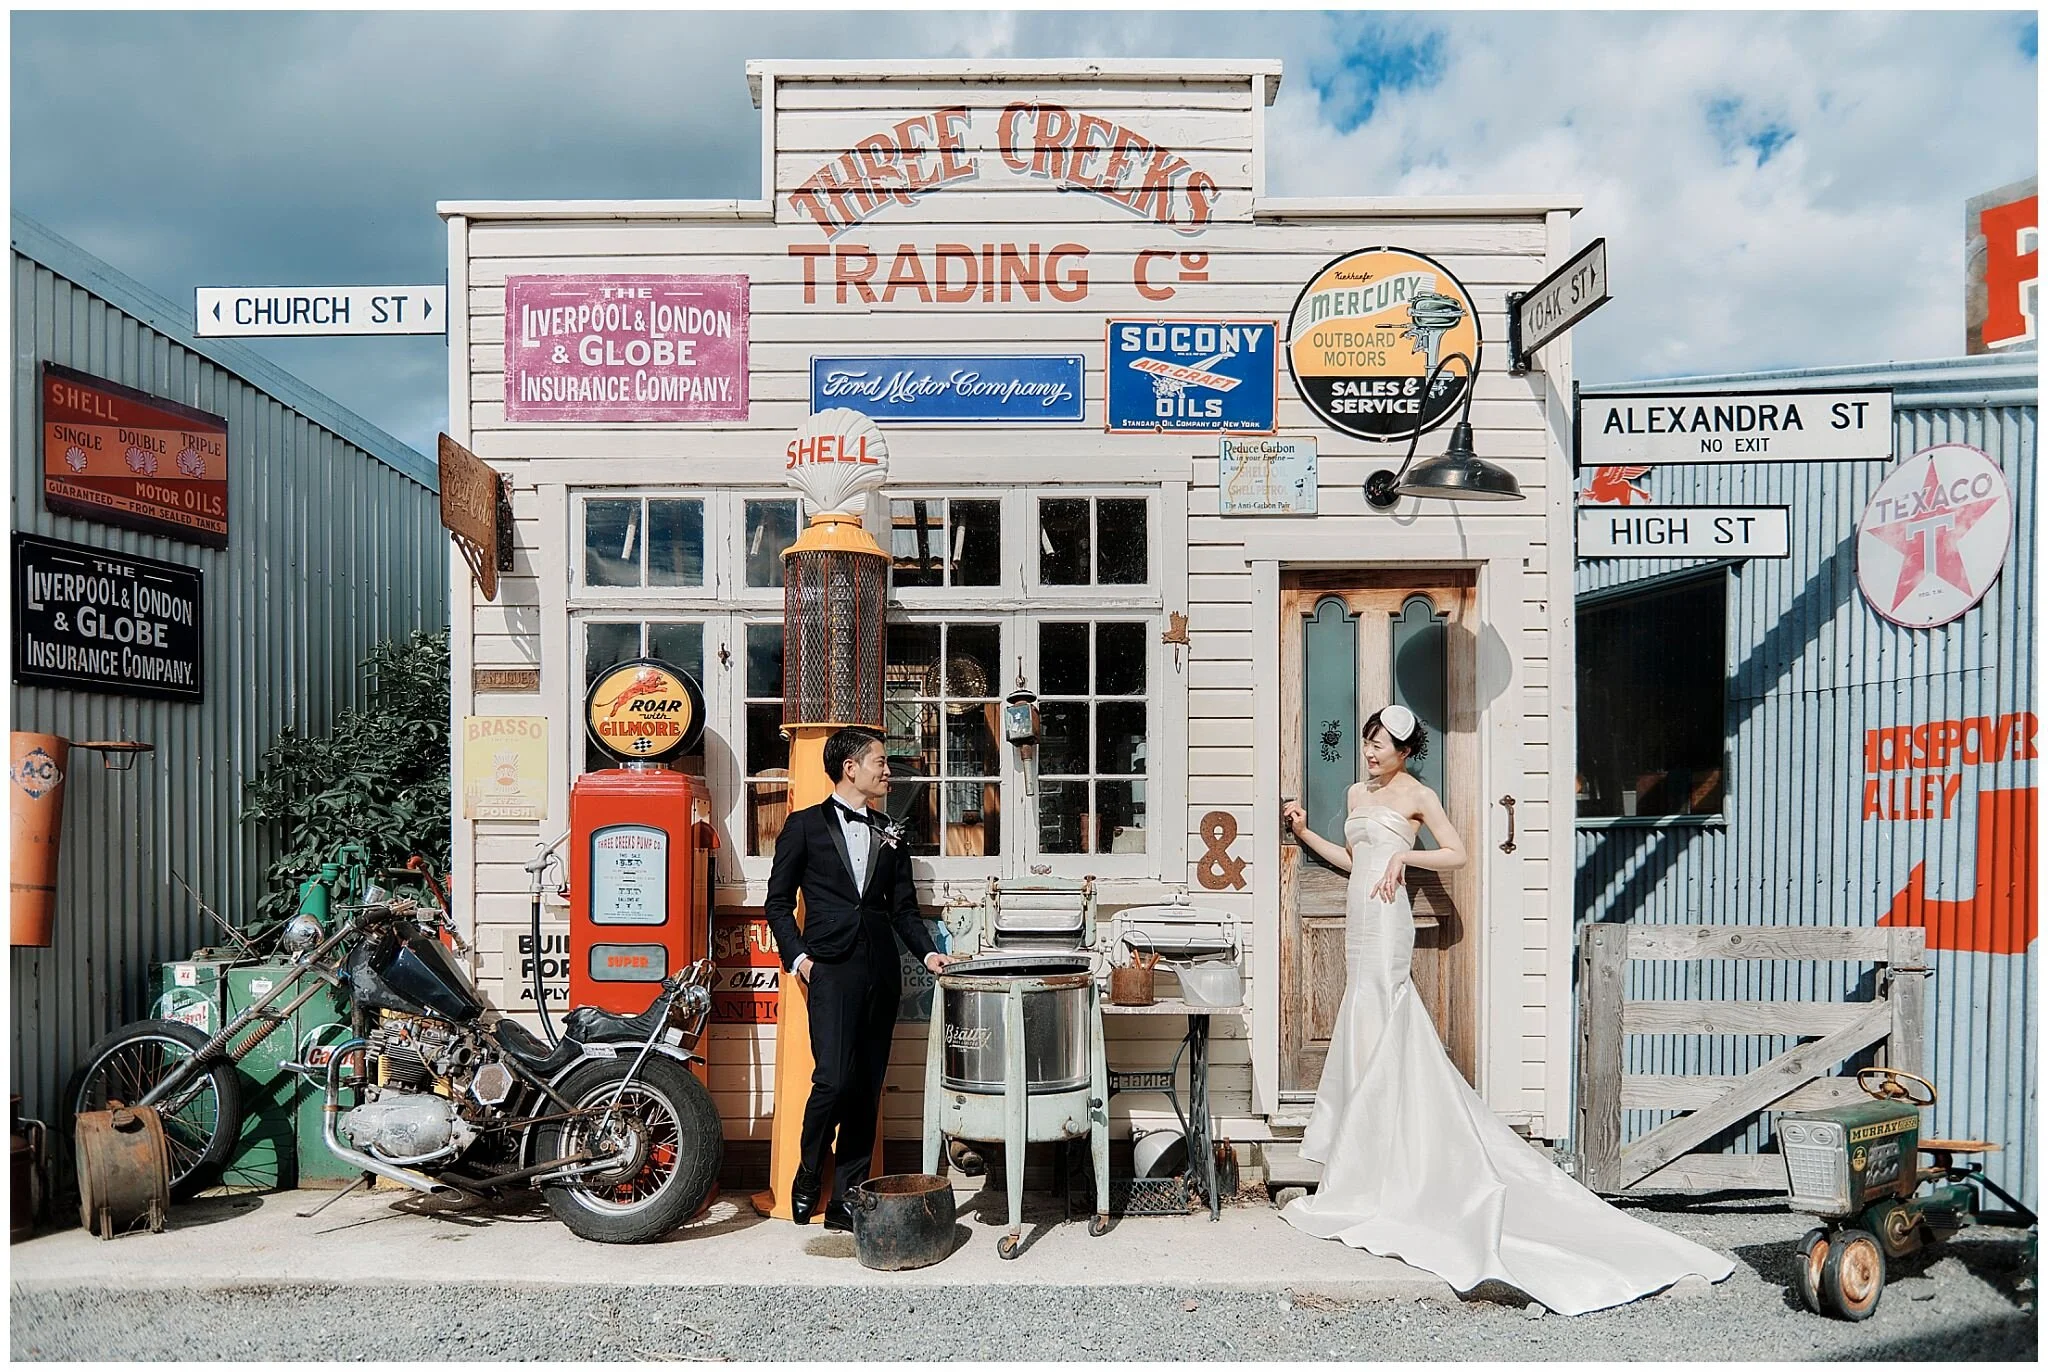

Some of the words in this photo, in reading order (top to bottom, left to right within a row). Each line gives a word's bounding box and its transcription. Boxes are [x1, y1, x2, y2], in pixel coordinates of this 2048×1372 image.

[788, 105, 980, 242] THREE
[995, 101, 1222, 238] CREEKS
[787, 243, 1092, 304] TRADING
[599, 288, 653, 299] THE
[1311, 277, 1421, 323] MERCURY
[1535, 286, 1562, 331] OAK
[1571, 266, 1588, 305] ST
[235, 297, 350, 325] CHURCH
[371, 296, 408, 323] ST
[522, 303, 632, 348] LIVERPOOL
[634, 310, 646, 331] &
[650, 301, 732, 339] LONDON
[551, 345, 571, 364] &
[578, 335, 697, 366] GLOBE
[1121, 327, 1263, 353] SOCONY
[1313, 332, 1396, 348] OUTBOARD
[1324, 351, 1386, 367] MOTORS
[521, 370, 630, 402] INSURANCE
[823, 371, 883, 398] Ford
[877, 370, 951, 404] Motor
[950, 369, 1073, 407] Company
[1331, 381, 1399, 397] SALES
[1402, 378, 1420, 396] &
[52, 383, 119, 422] SHELL
[1156, 399, 1223, 418] OILS
[1331, 399, 1420, 414] SERVICE
[1162, 419, 1174, 427] OIL
[1176, 420, 1210, 428] COMPANY
[1223, 420, 1239, 428] NEW
[1240, 420, 1260, 428] YORK
[1603, 403, 1804, 434] ALEXANDRA
[1830, 401, 1870, 430] ST
[54, 424, 102, 450] SINGLE
[118, 429, 166, 454] DOUBLE
[180, 432, 221, 456] TRIPLE
[786, 434, 879, 470] SHELL
[1223, 440, 1259, 461] Reduce
[1260, 441, 1295, 453] Carbon
[1701, 438, 1723, 453] NO
[1735, 437, 1770, 453] EXIT
[49, 482, 113, 506] GUARANTEED
[129, 501, 155, 516] FROM
[159, 509, 192, 525] SEALED
[136, 482, 179, 506] MOTOR
[184, 489, 225, 518] OILS.
[1876, 472, 1993, 523] TEXACO
[1611, 517, 1689, 545] HIGH
[1714, 517, 1755, 544] ST
[1906, 512, 1955, 576] T
[92, 560, 135, 578] THE
[27, 564, 119, 611] LIVERPOOL
[121, 587, 131, 609] &
[133, 581, 192, 626] LONDON
[53, 611, 70, 632] &
[76, 606, 168, 648] GLOBE
[27, 632, 118, 676] INSURANCE
[480, 671, 536, 686] ANTIQUES
[629, 699, 682, 712] ROAR
[468, 719, 542, 741] BRASSO
[600, 721, 681, 737] GILMORE
[1863, 773, 1962, 821] ALLEY
[480, 806, 531, 817] POLISH
[598, 837, 613, 848] THREE
[615, 836, 635, 849] CREEKS
[637, 836, 652, 849] PUMP
[1197, 811, 1247, 891] &
[607, 955, 648, 968] SUPER
[712, 1000, 778, 1019] ANTI
[1852, 1121, 1898, 1140] MURRAY
[1856, 1149, 1863, 1158] 2
